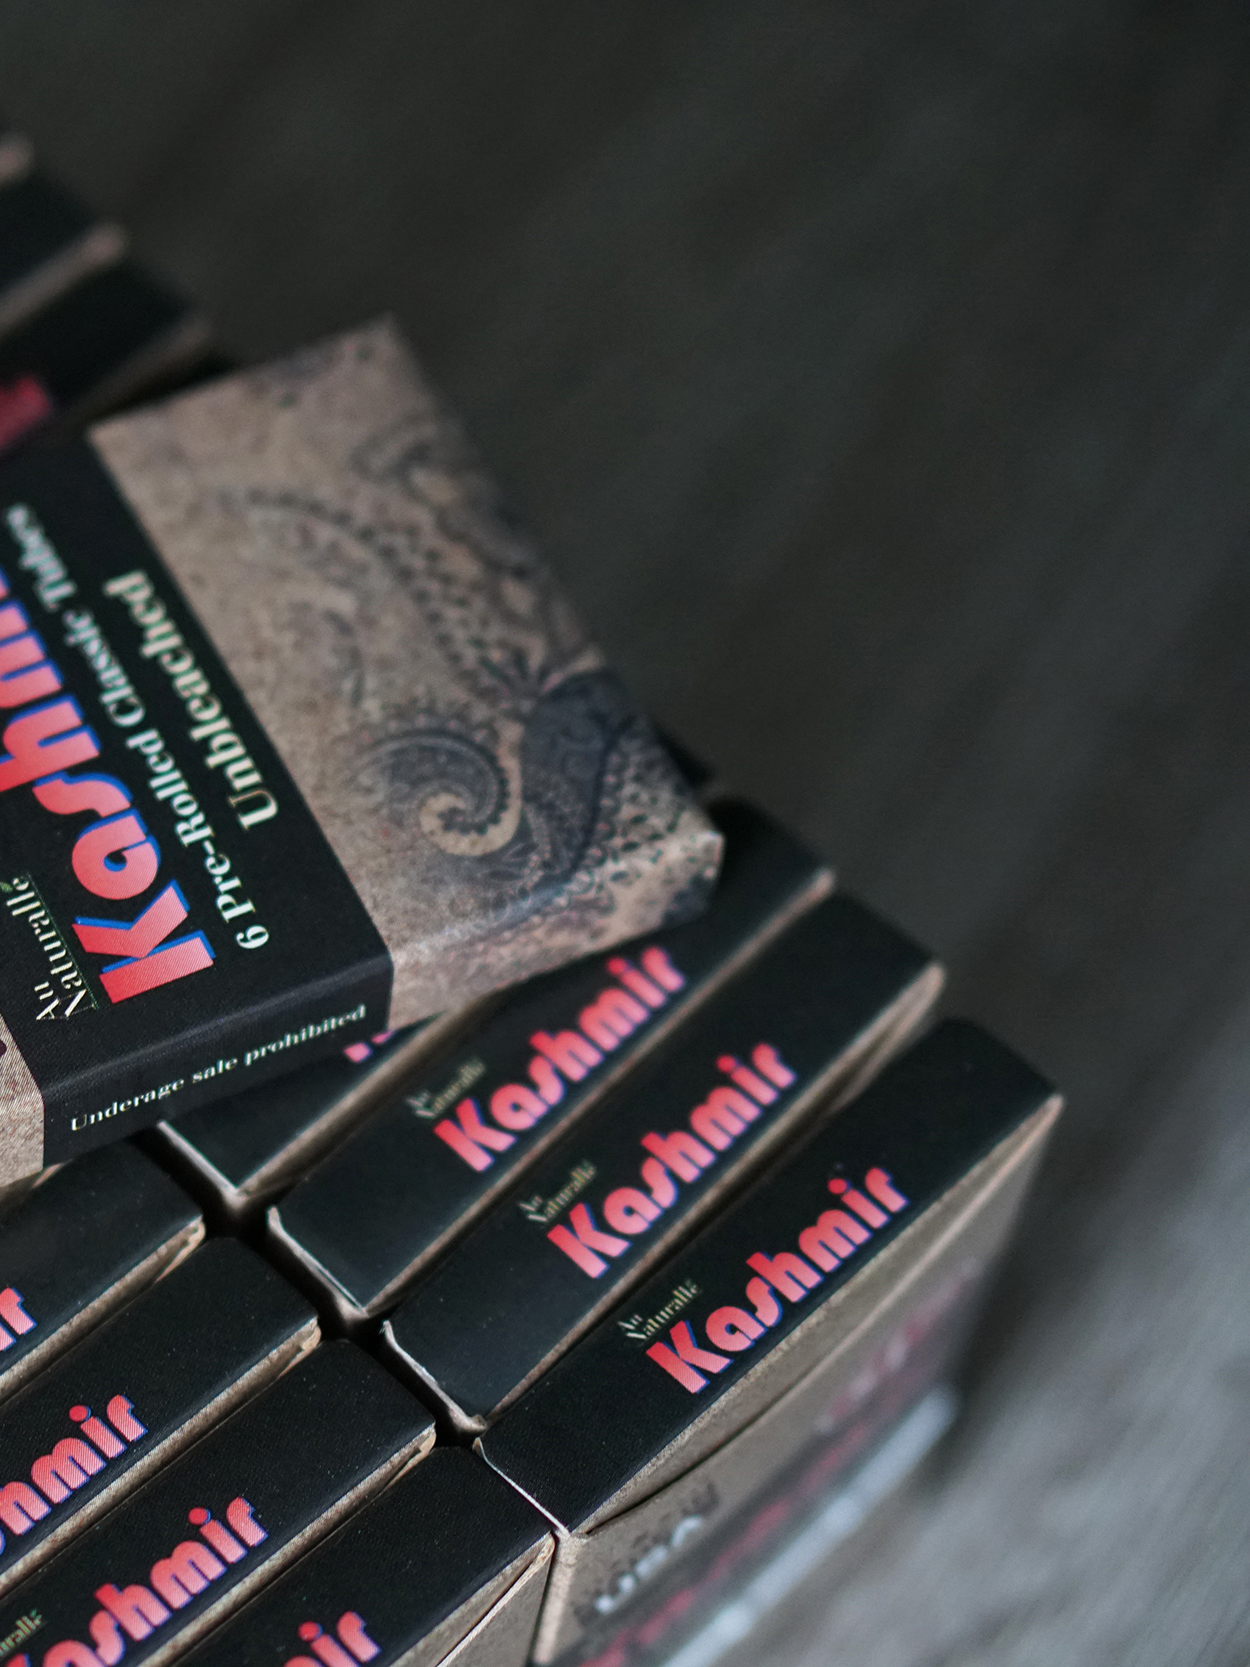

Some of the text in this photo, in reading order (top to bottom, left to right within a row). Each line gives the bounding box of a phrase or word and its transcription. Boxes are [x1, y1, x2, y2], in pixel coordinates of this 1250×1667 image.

[6, 504, 270, 950] 6 Pre-Rolled Classic Tubes
[103, 570, 279, 830] Unbleached
[34, 980, 63, 1021] Au
[70, 1077, 185, 1131] Underage
[192, 1056, 238, 1084] sale
[244, 1003, 367, 1066] prohibited
[433, 946, 686, 1172] Kashmir
[546, 1043, 796, 1278] Kashmir
[645, 1167, 908, 1394] Kashmir
[3, 1496, 269, 1667] ashmir
